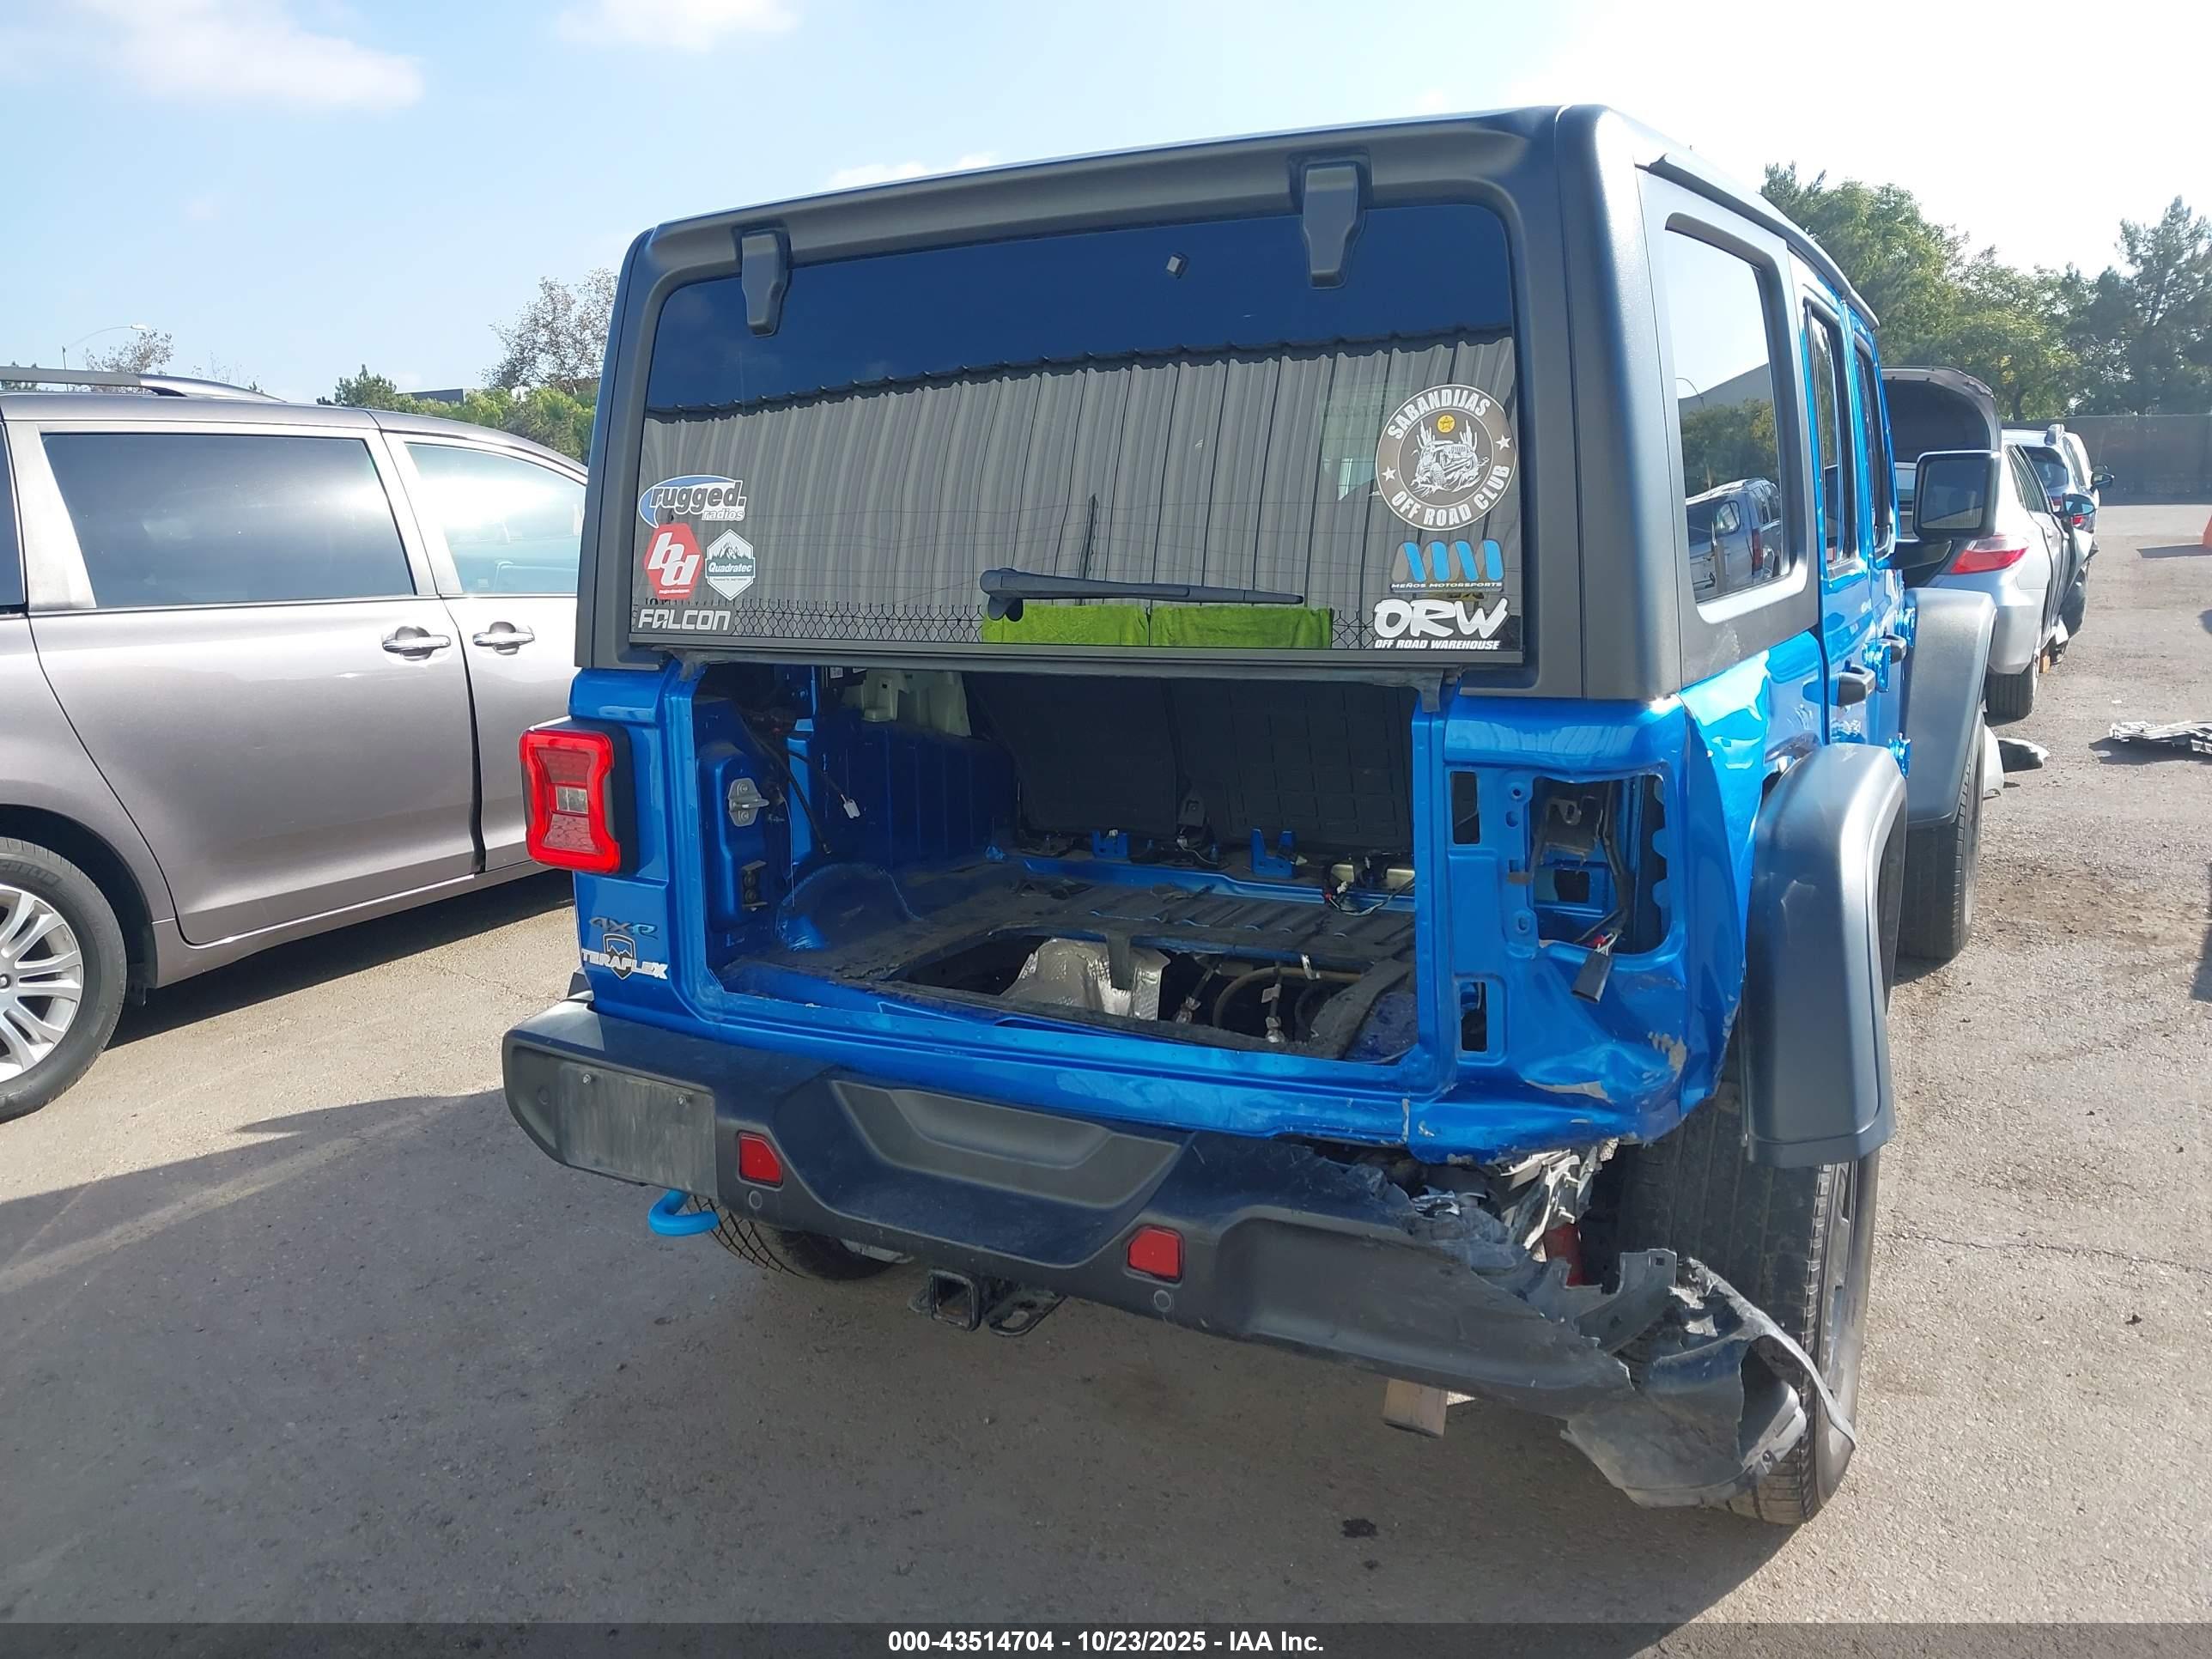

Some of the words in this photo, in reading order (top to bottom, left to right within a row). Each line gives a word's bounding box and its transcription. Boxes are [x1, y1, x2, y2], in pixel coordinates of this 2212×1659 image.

[1387, 388, 1491, 440] SABANDIJAS
[1390, 490, 1422, 520] OFF
[1423, 503, 1472, 526] ROAD
[1474, 465, 1510, 510] CLUB
[702, 508, 745, 521] radios
[708, 562, 753, 574] Quadratec
[638, 608, 732, 631] FALCON
[1374, 598, 1509, 639] ORW
[1374, 639, 1395, 649] OFF
[1396, 639, 1428, 649] ROAD
[1431, 640, 1501, 650] WAREHOUSE
[581, 947, 669, 980] TERAFLEX
